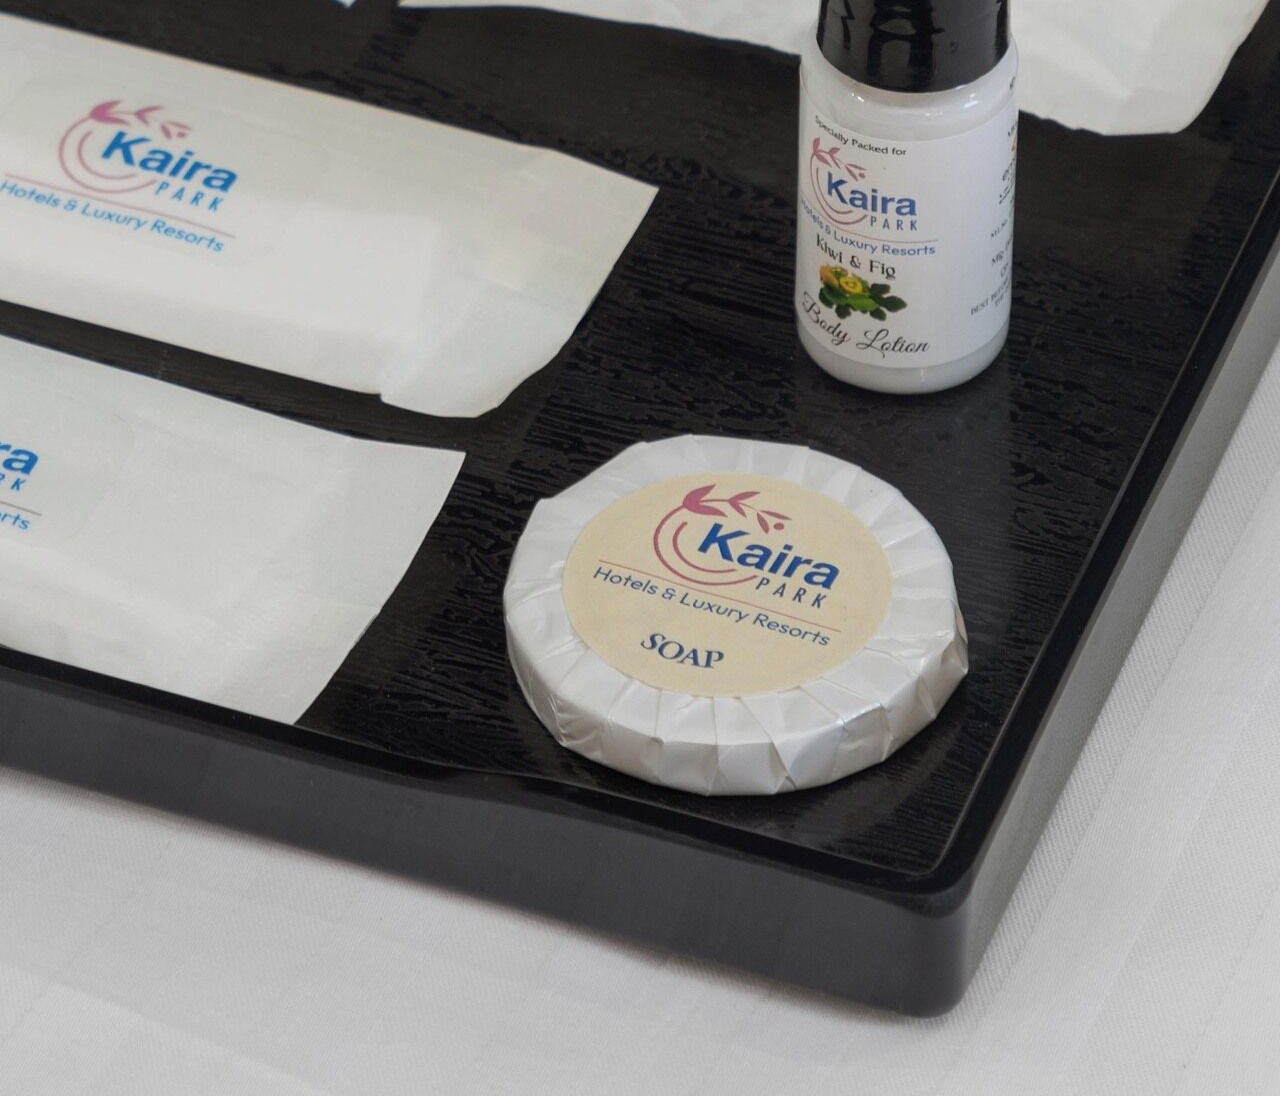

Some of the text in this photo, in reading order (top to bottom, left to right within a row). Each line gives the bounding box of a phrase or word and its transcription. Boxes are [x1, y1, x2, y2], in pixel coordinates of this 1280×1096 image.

[100, 130, 238, 193] Kaira
[851, 138, 889, 155] Packed
[891, 147, 907, 156] for
[154, 180, 225, 213] PARK
[827, 171, 917, 217] Kaira
[63, 197, 77, 212] &
[80, 200, 149, 231] Luxury
[150, 218, 225, 253] Resorts
[834, 230, 878, 255] Luxury
[882, 244, 936, 257] Resorts
[870, 214, 918, 231] PARK
[816, 233, 896, 280] Kiwi & Fig
[802, 291, 930, 359] Body Lotion
[697, 522, 840, 590] Kaira
[592, 566, 831, 646] Hotels & Luxury Resorts
[755, 577, 828, 609] PARK
[640, 632, 725, 669] SOAP
